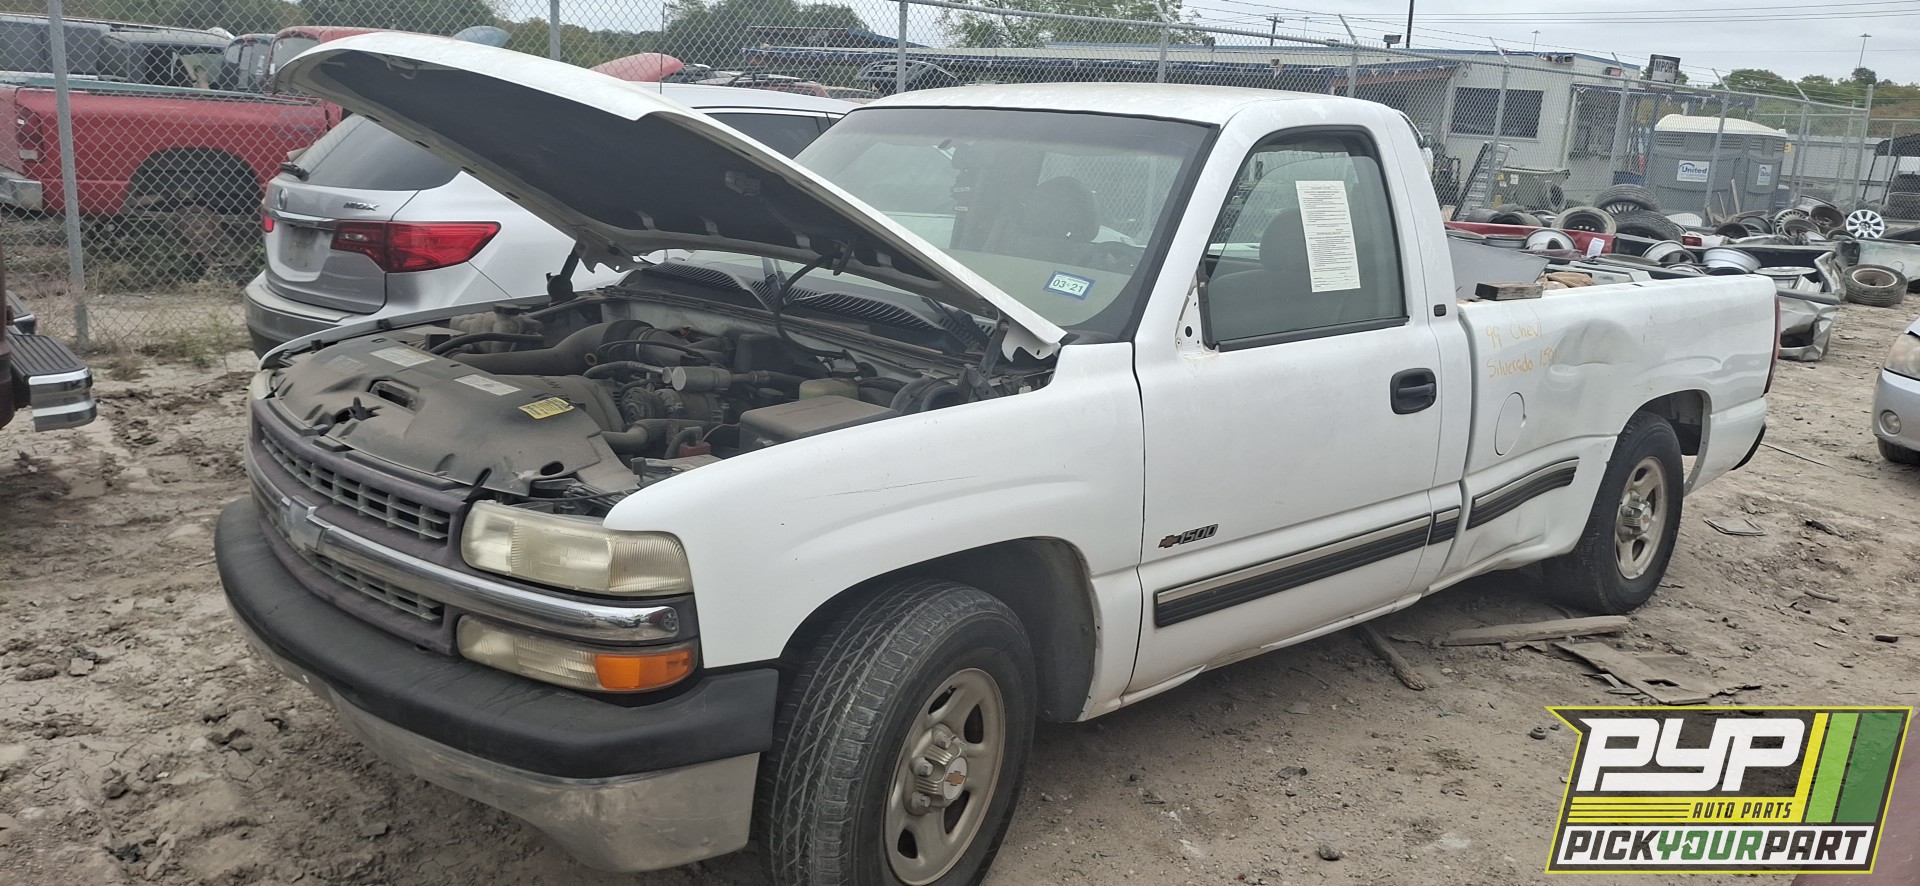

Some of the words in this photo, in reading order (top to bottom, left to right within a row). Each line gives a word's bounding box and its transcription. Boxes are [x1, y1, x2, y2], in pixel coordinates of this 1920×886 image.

[1681, 166, 1708, 174] United
[1052, 279, 1067, 289] 03
[1070, 283, 1084, 293] 21
[1485, 325, 1503, 349] 99
[1486, 353, 1534, 378] Silverado
[1179, 523, 1219, 545] 1500
